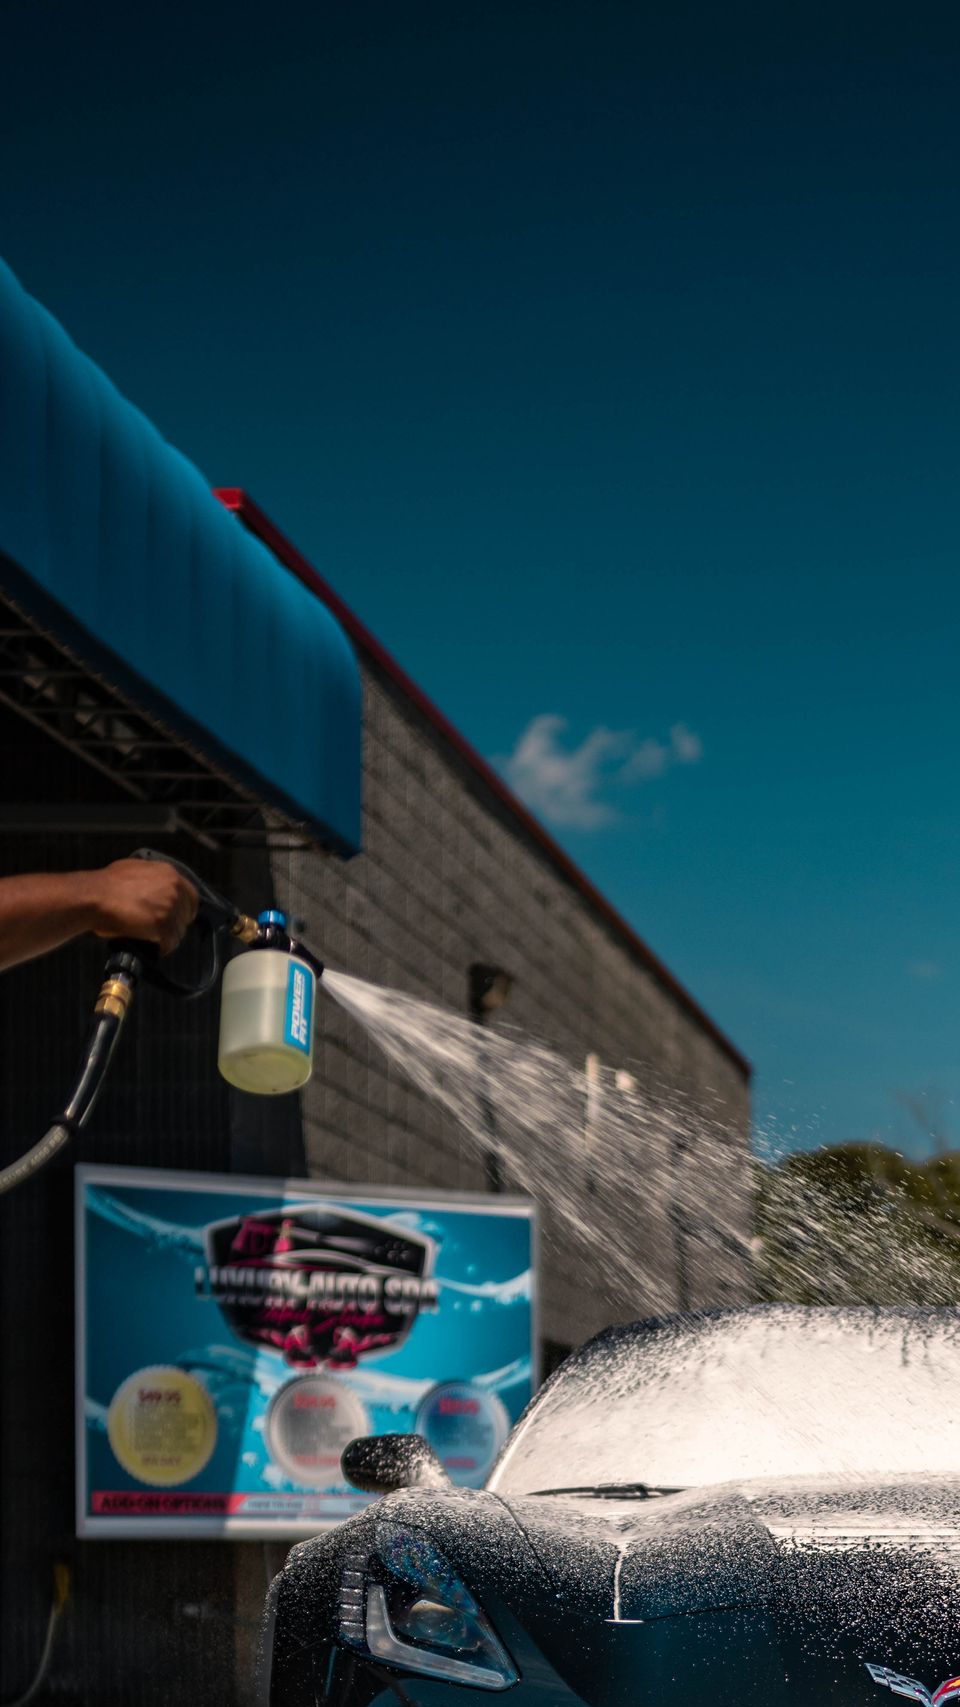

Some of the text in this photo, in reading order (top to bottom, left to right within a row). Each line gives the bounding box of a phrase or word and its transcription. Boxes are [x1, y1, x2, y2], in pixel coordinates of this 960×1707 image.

[291, 969, 304, 1040] POWER
[299, 1017, 307, 1046] FIT
[307, 1271, 379, 1313] AUTO
[384, 1275, 440, 1316] SPA
